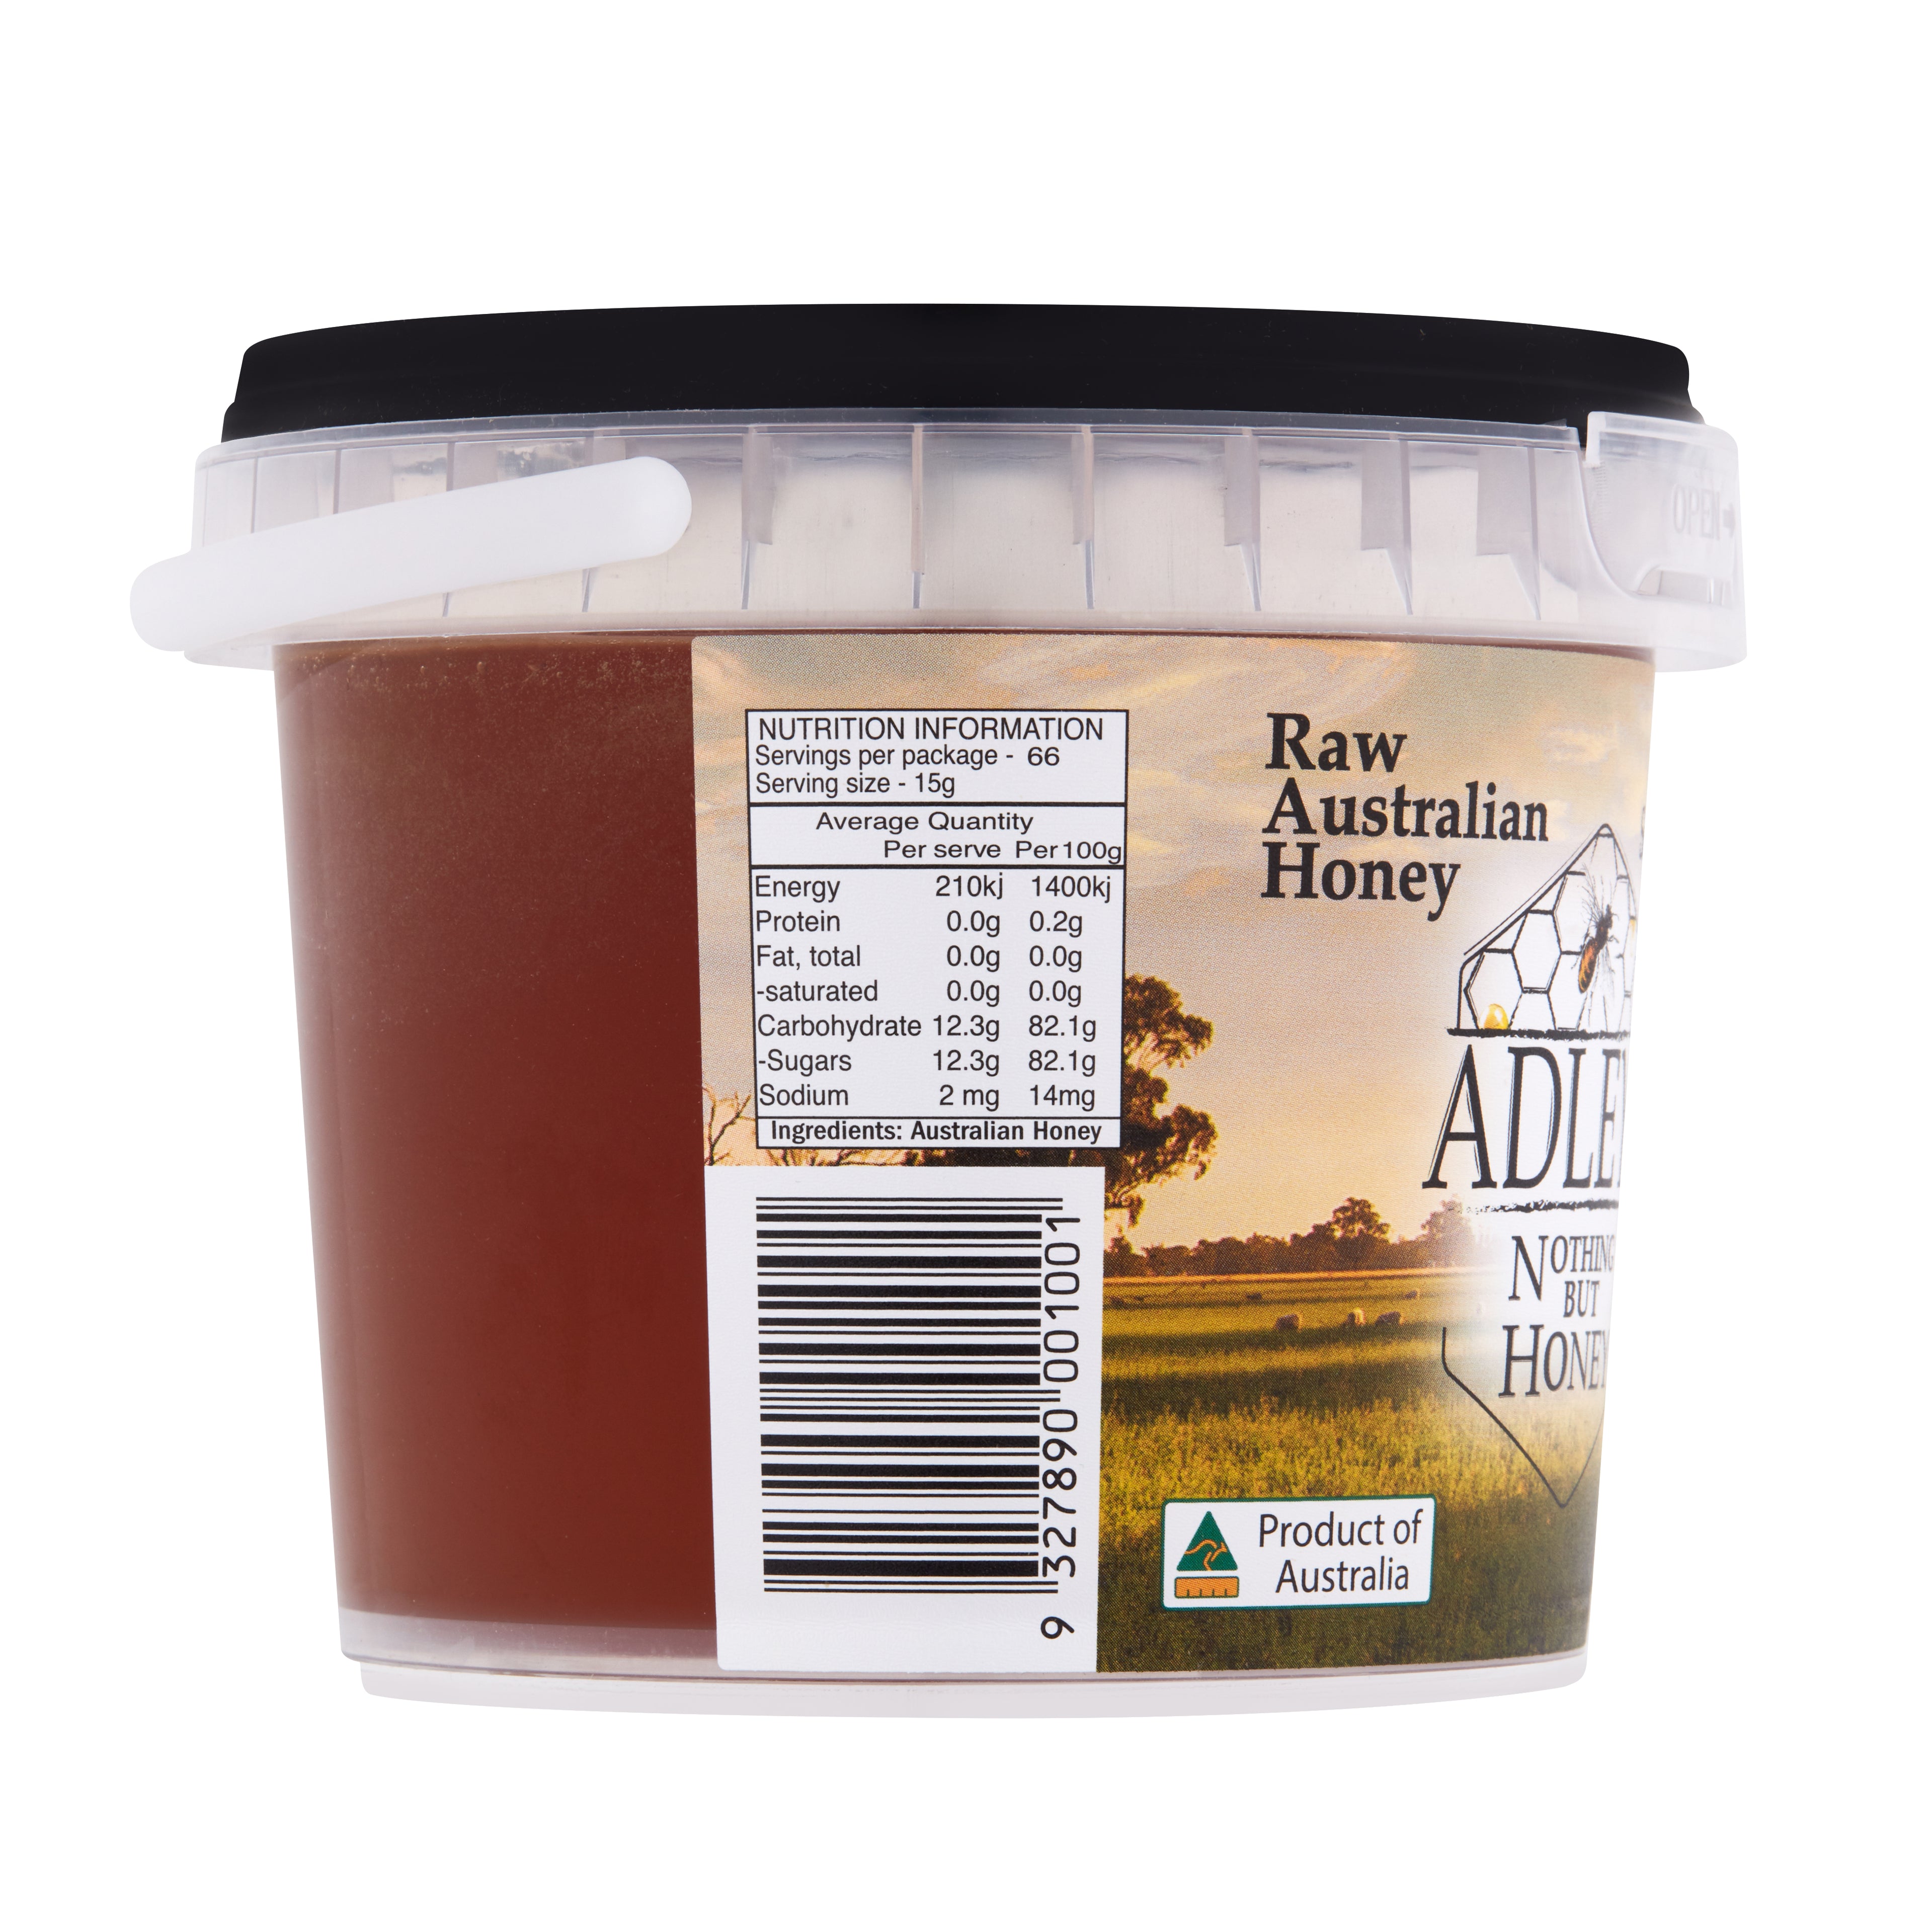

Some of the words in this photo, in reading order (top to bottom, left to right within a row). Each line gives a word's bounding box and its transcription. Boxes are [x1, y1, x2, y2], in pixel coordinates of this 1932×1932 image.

[760, 717, 904, 741] NUTRITION
[916, 716, 1102, 741] INFORMATION
[1264, 712, 1408, 773] Raw
[756, 744, 851, 771] Servings
[859, 749, 895, 770] per
[903, 744, 998, 770] package
[1027, 747, 1060, 766] 66
[756, 772, 838, 798] Serving
[847, 772, 890, 793] size
[915, 772, 954, 798] 15g
[816, 812, 919, 835] Average
[928, 812, 1033, 835] Quantity
[1262, 777, 1548, 841] Australian
[884, 840, 927, 858] Per
[934, 844, 1001, 858] serve
[1016, 840, 1058, 859] Per
[1064, 841, 1121, 865] 100g
[756, 875, 840, 903] Energy
[936, 872, 1003, 900] 210kj
[1032, 875, 1110, 904] 1400kj
[1260, 841, 1461, 922] Honey
[756, 910, 840, 932] Protein
[947, 910, 1000, 938] 0.0g
[1029, 910, 1082, 938] 0.2g
[757, 945, 800, 971] Fat,
[809, 944, 860, 967] total
[947, 945, 1000, 973] 0.0g
[1029, 945, 1082, 973] 0.0g
[757, 980, 877, 1002] -saturated
[947, 980, 1000, 1007] 0.0g
[1029, 980, 1081, 1008] 0.0g
[758, 1014, 922, 1042] Carbohydrate
[933, 1015, 999, 1042] 12.3g
[1029, 1015, 1096, 1042] 82.1g
[759, 1049, 852, 1077] -Sugars
[933, 1050, 999, 1077] 12.3g
[1028, 1050, 1095, 1077] 82.1g
[760, 1083, 848, 1106] Sodium
[939, 1084, 953, 1105] 2
[963, 1089, 999, 1112] mg
[1030, 1084, 1095, 1112] 14mg
[1420, 1042, 1626, 1189] ADLE
[772, 1120, 902, 1144] Ingredients:
[911, 1120, 1023, 1140] Australian
[1034, 1120, 1102, 1145] Honey
[1043, 1217, 1081, 1383] 001001
[1563, 1280, 1600, 1318] BUT
[1042, 1408, 1078, 1578] 327890
[1259, 1511, 1385, 1547] Product
[1394, 1508, 1423, 1545] of
[1275, 1556, 1408, 1593] Australia
[1040, 1616, 1075, 1639] 9
